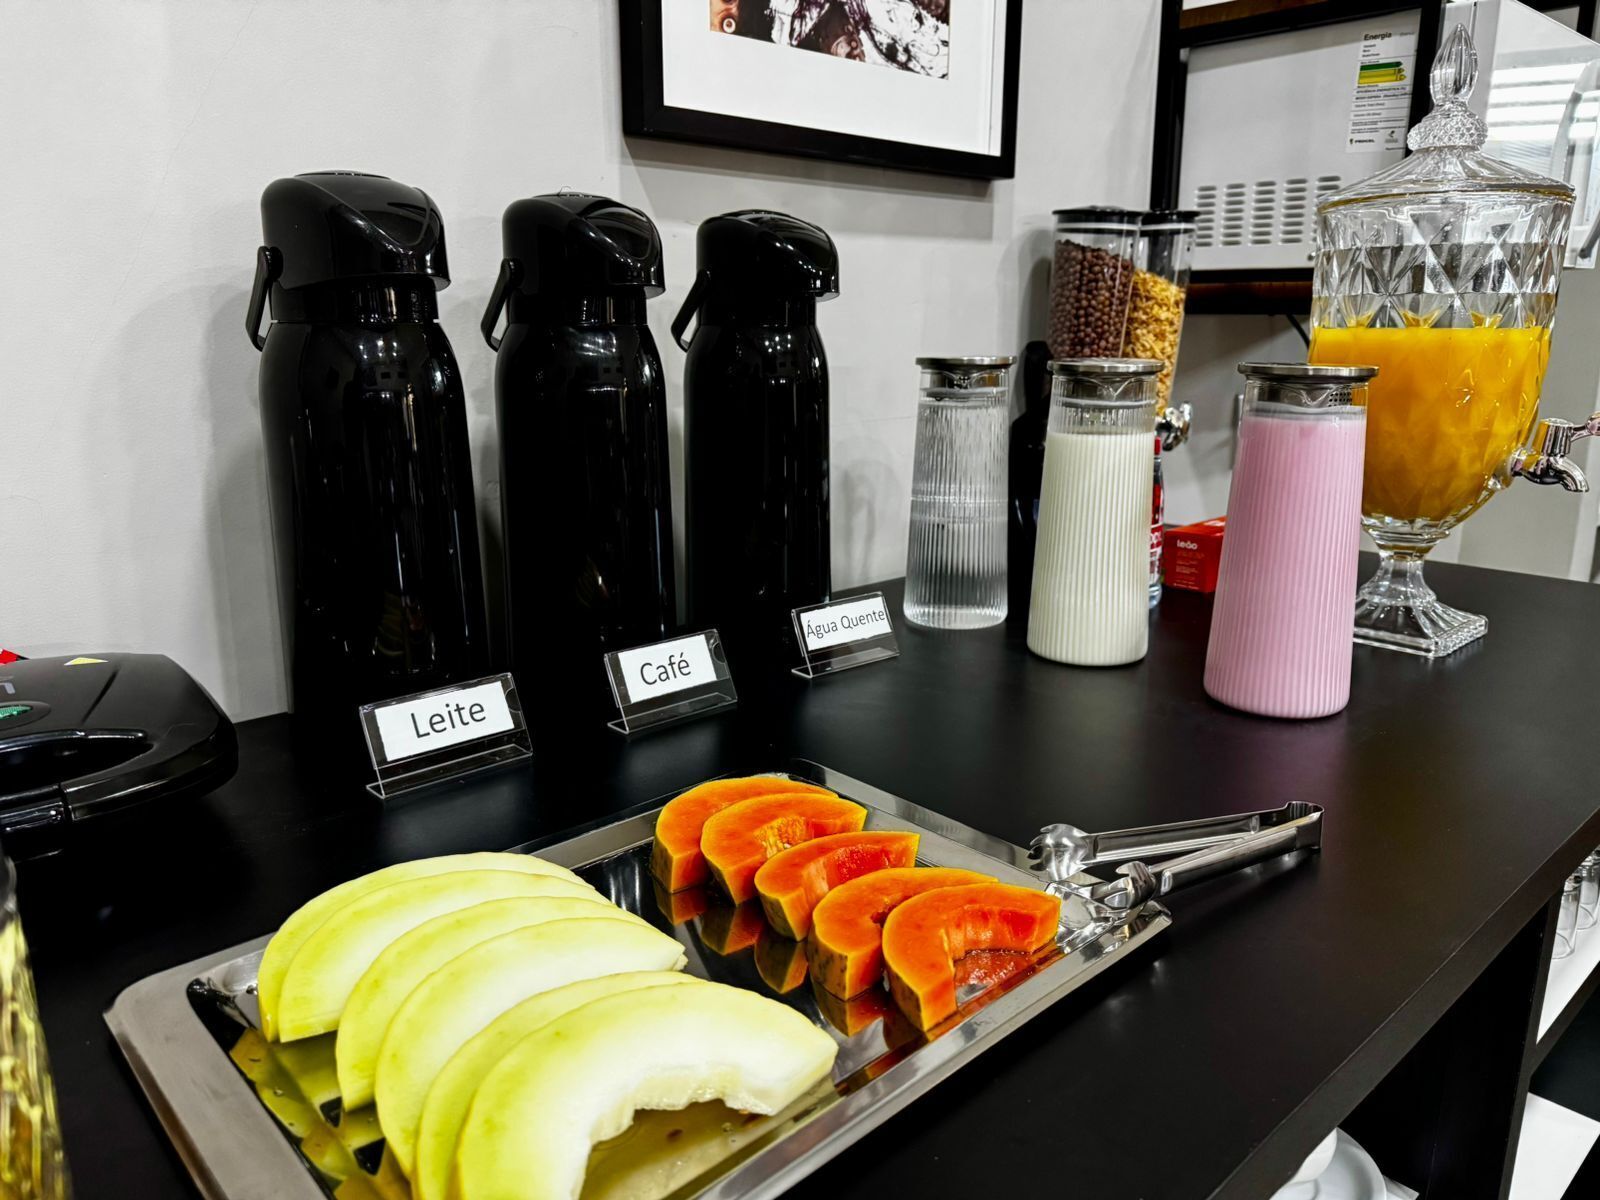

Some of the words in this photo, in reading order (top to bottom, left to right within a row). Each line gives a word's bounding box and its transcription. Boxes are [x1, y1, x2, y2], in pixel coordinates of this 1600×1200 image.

[1363, 32, 1392, 41] Energia
[806, 619, 838, 639] Água
[840, 609, 886, 630] Quente
[640, 652, 691, 685] Café
[410, 702, 486, 738] Leite
